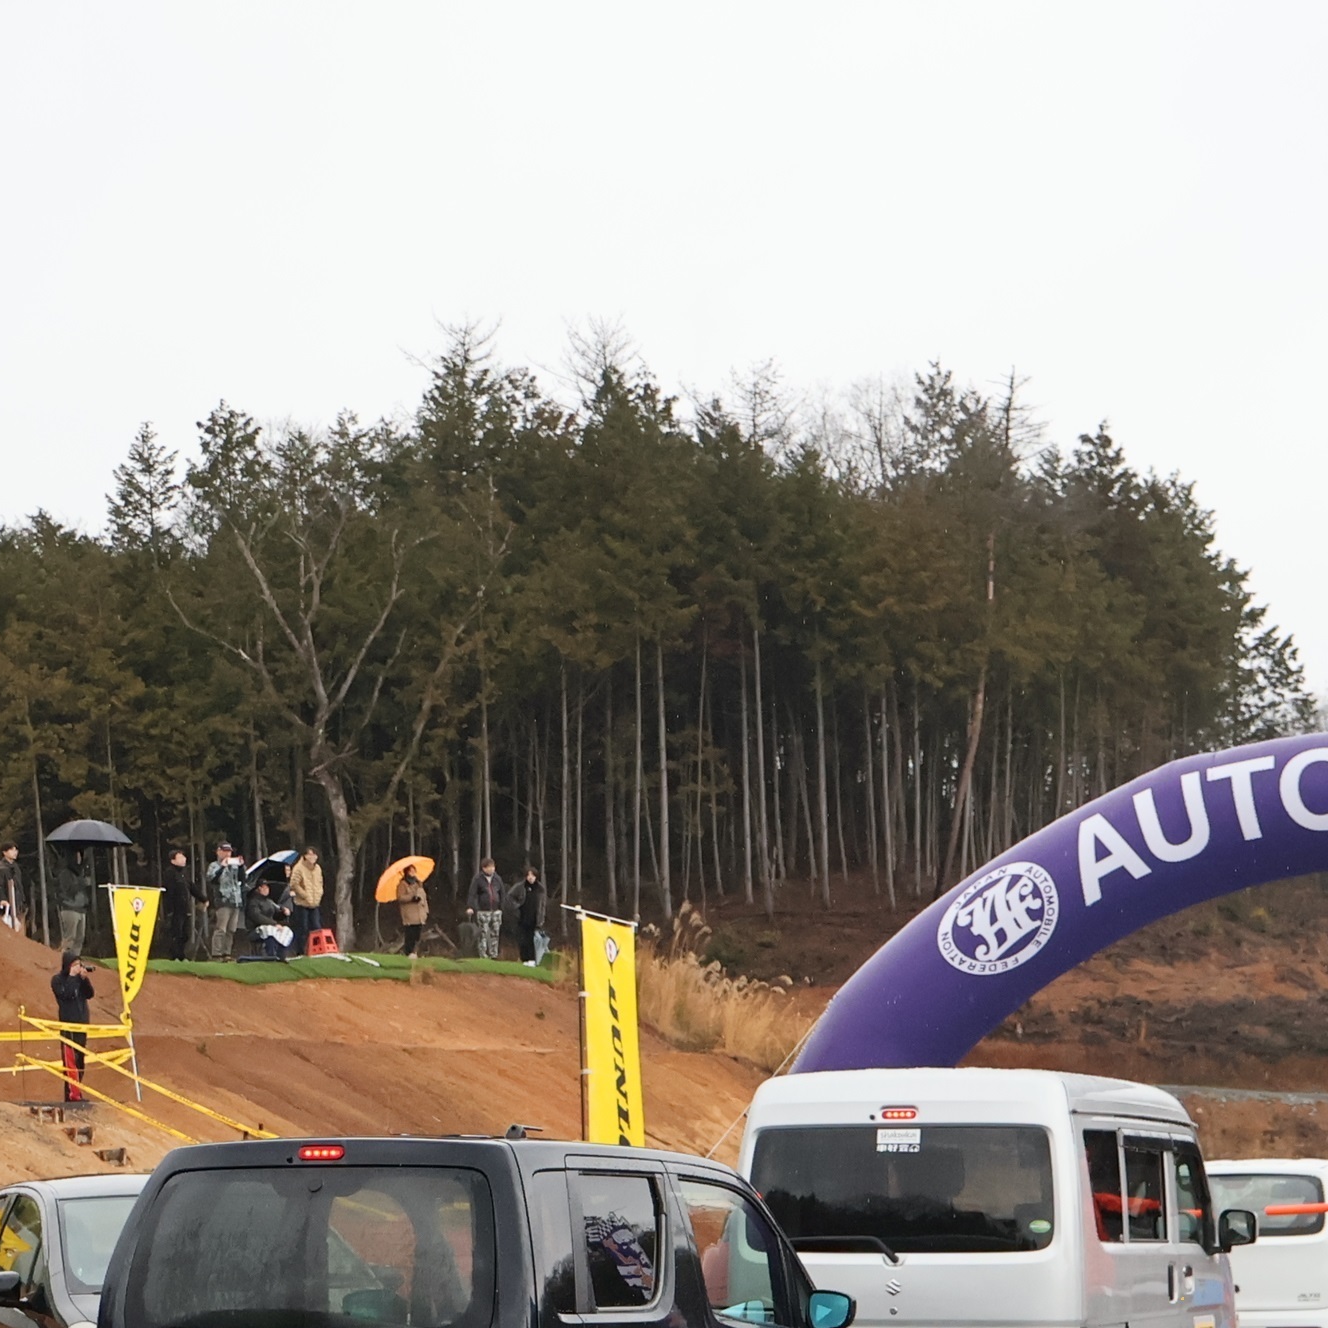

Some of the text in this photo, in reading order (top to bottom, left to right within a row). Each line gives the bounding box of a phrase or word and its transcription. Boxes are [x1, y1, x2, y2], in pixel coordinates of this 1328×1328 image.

[941, 866, 1055, 973] JAPAN AUTOMOBILE FEDERATION
